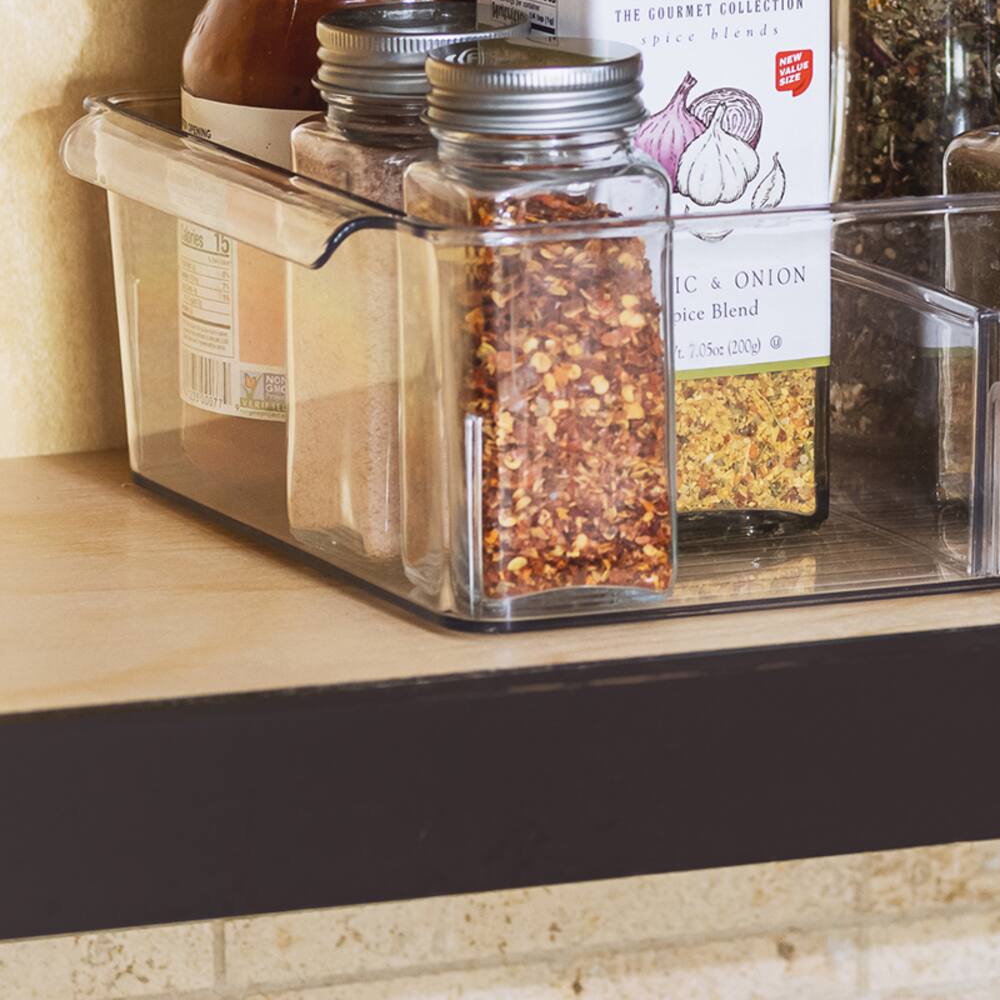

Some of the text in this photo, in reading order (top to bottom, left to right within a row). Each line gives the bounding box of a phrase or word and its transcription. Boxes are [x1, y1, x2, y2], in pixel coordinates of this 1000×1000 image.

[615, 8, 641, 23] THE
[648, 3, 712, 21] GOURMET
[641, 23, 780, 47] spice blends
[779, 52, 802, 67] NEW
[779, 60, 809, 77] VALUE
[779, 73, 801, 86] SIZE
[214, 232, 230, 254] 15
[710, 276, 722, 290] &
[734, 266, 807, 290] ONION
[712, 299, 759, 320] Blend
[688, 341, 724, 359] 7.05oz
[727, 337, 761, 357] (200g)
